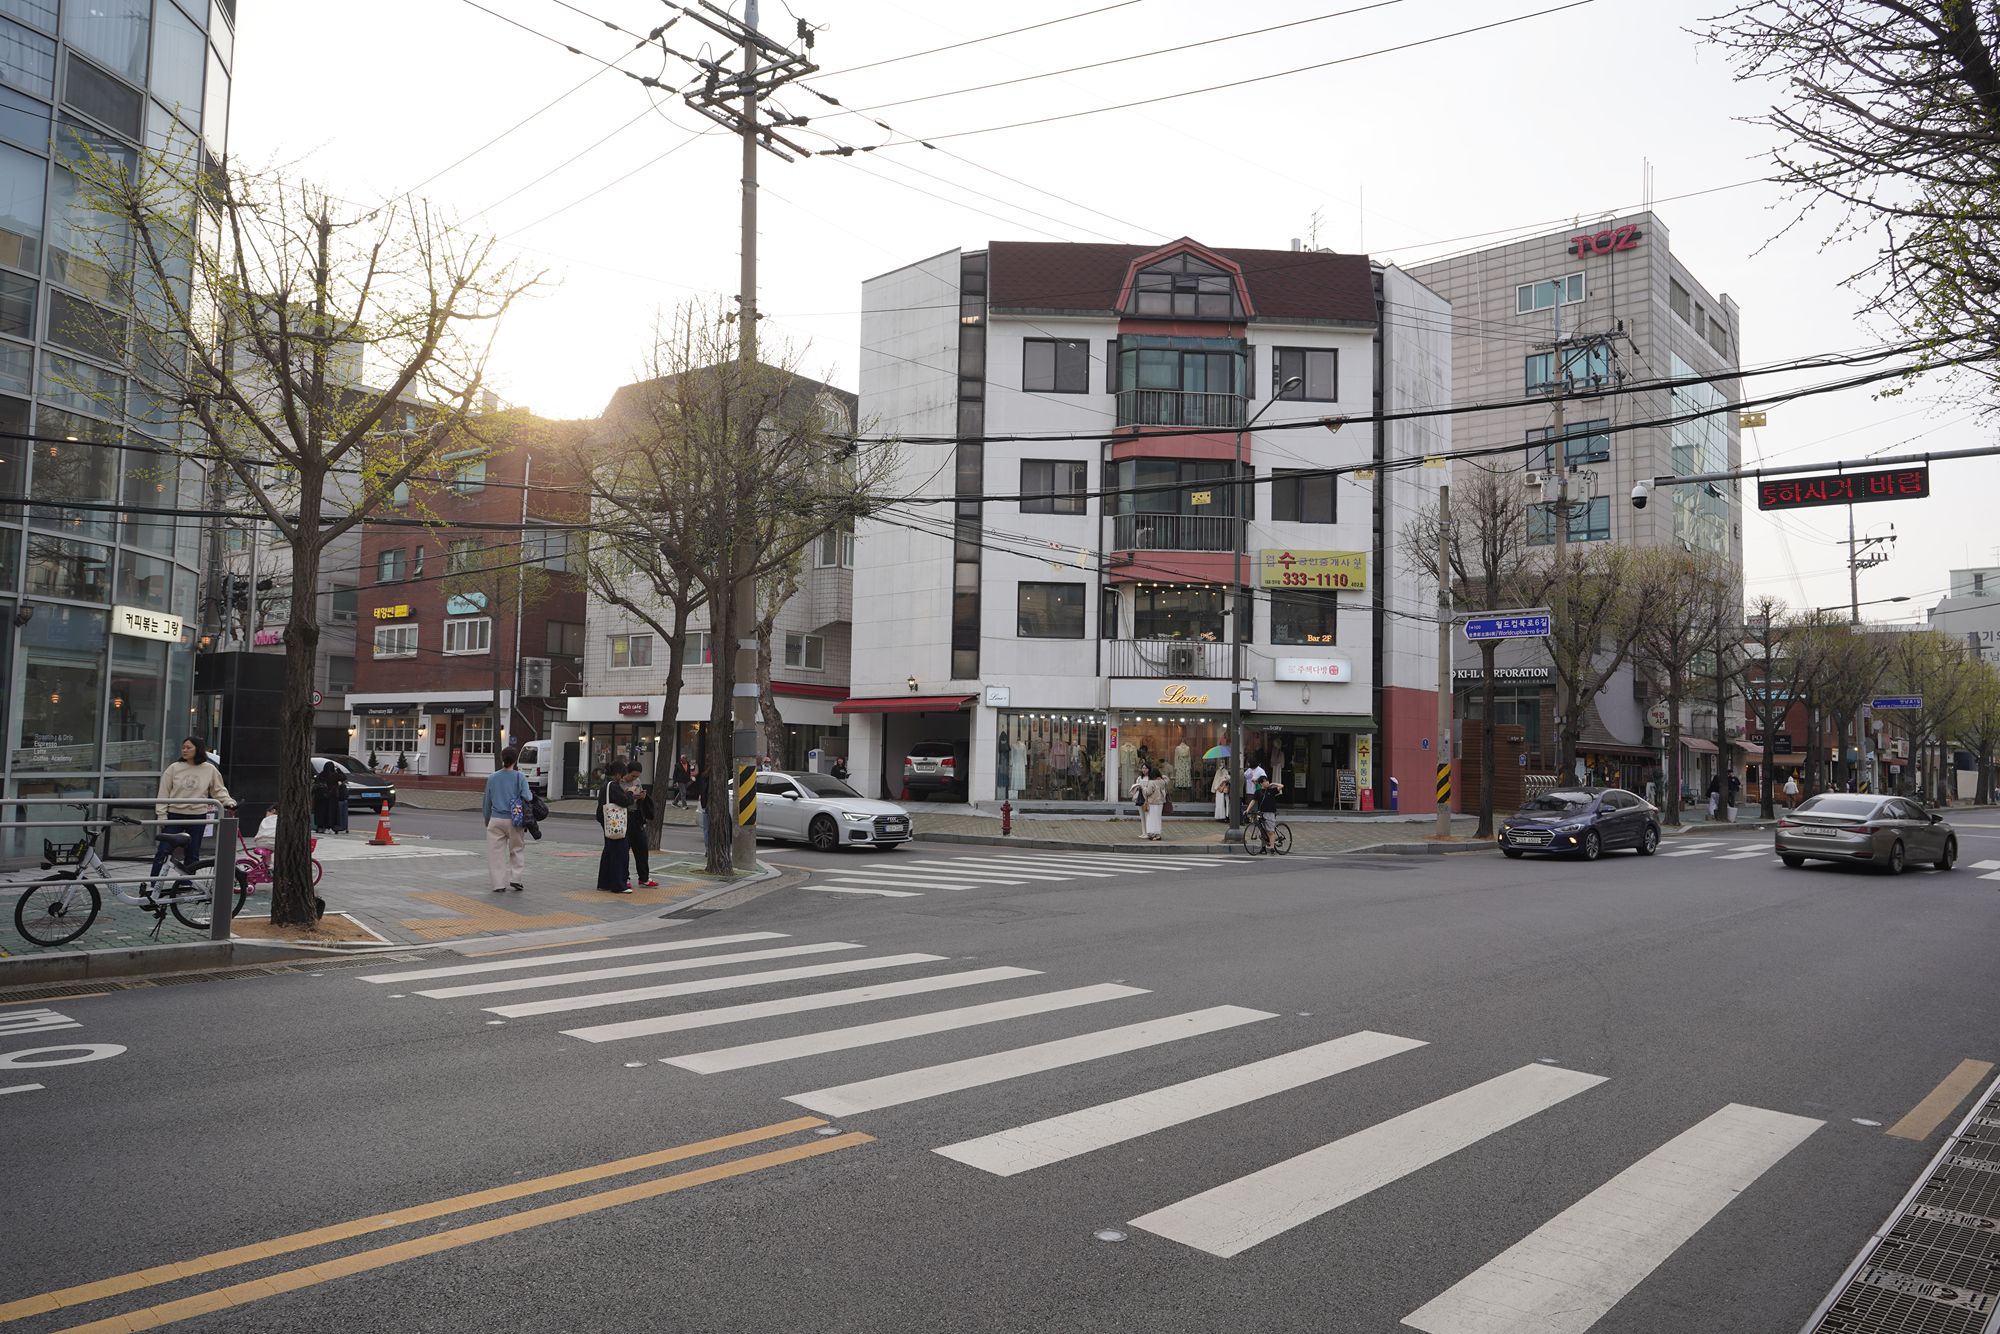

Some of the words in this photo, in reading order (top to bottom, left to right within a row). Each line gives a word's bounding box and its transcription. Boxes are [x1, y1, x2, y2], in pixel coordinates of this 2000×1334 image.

[1571, 223, 1637, 259] TOZ
[1283, 572, 1348, 587] 333-1110
[125, 613, 158, 633] 커피볶는
[163, 620, 179, 636] 그랑
[1495, 618, 1548, 629] 월드컵북로6길
[1307, 634, 1320, 642] Bar
[1458, 669, 1479, 679] KI-IL
[1481, 667, 1549, 678] CRPORATION
